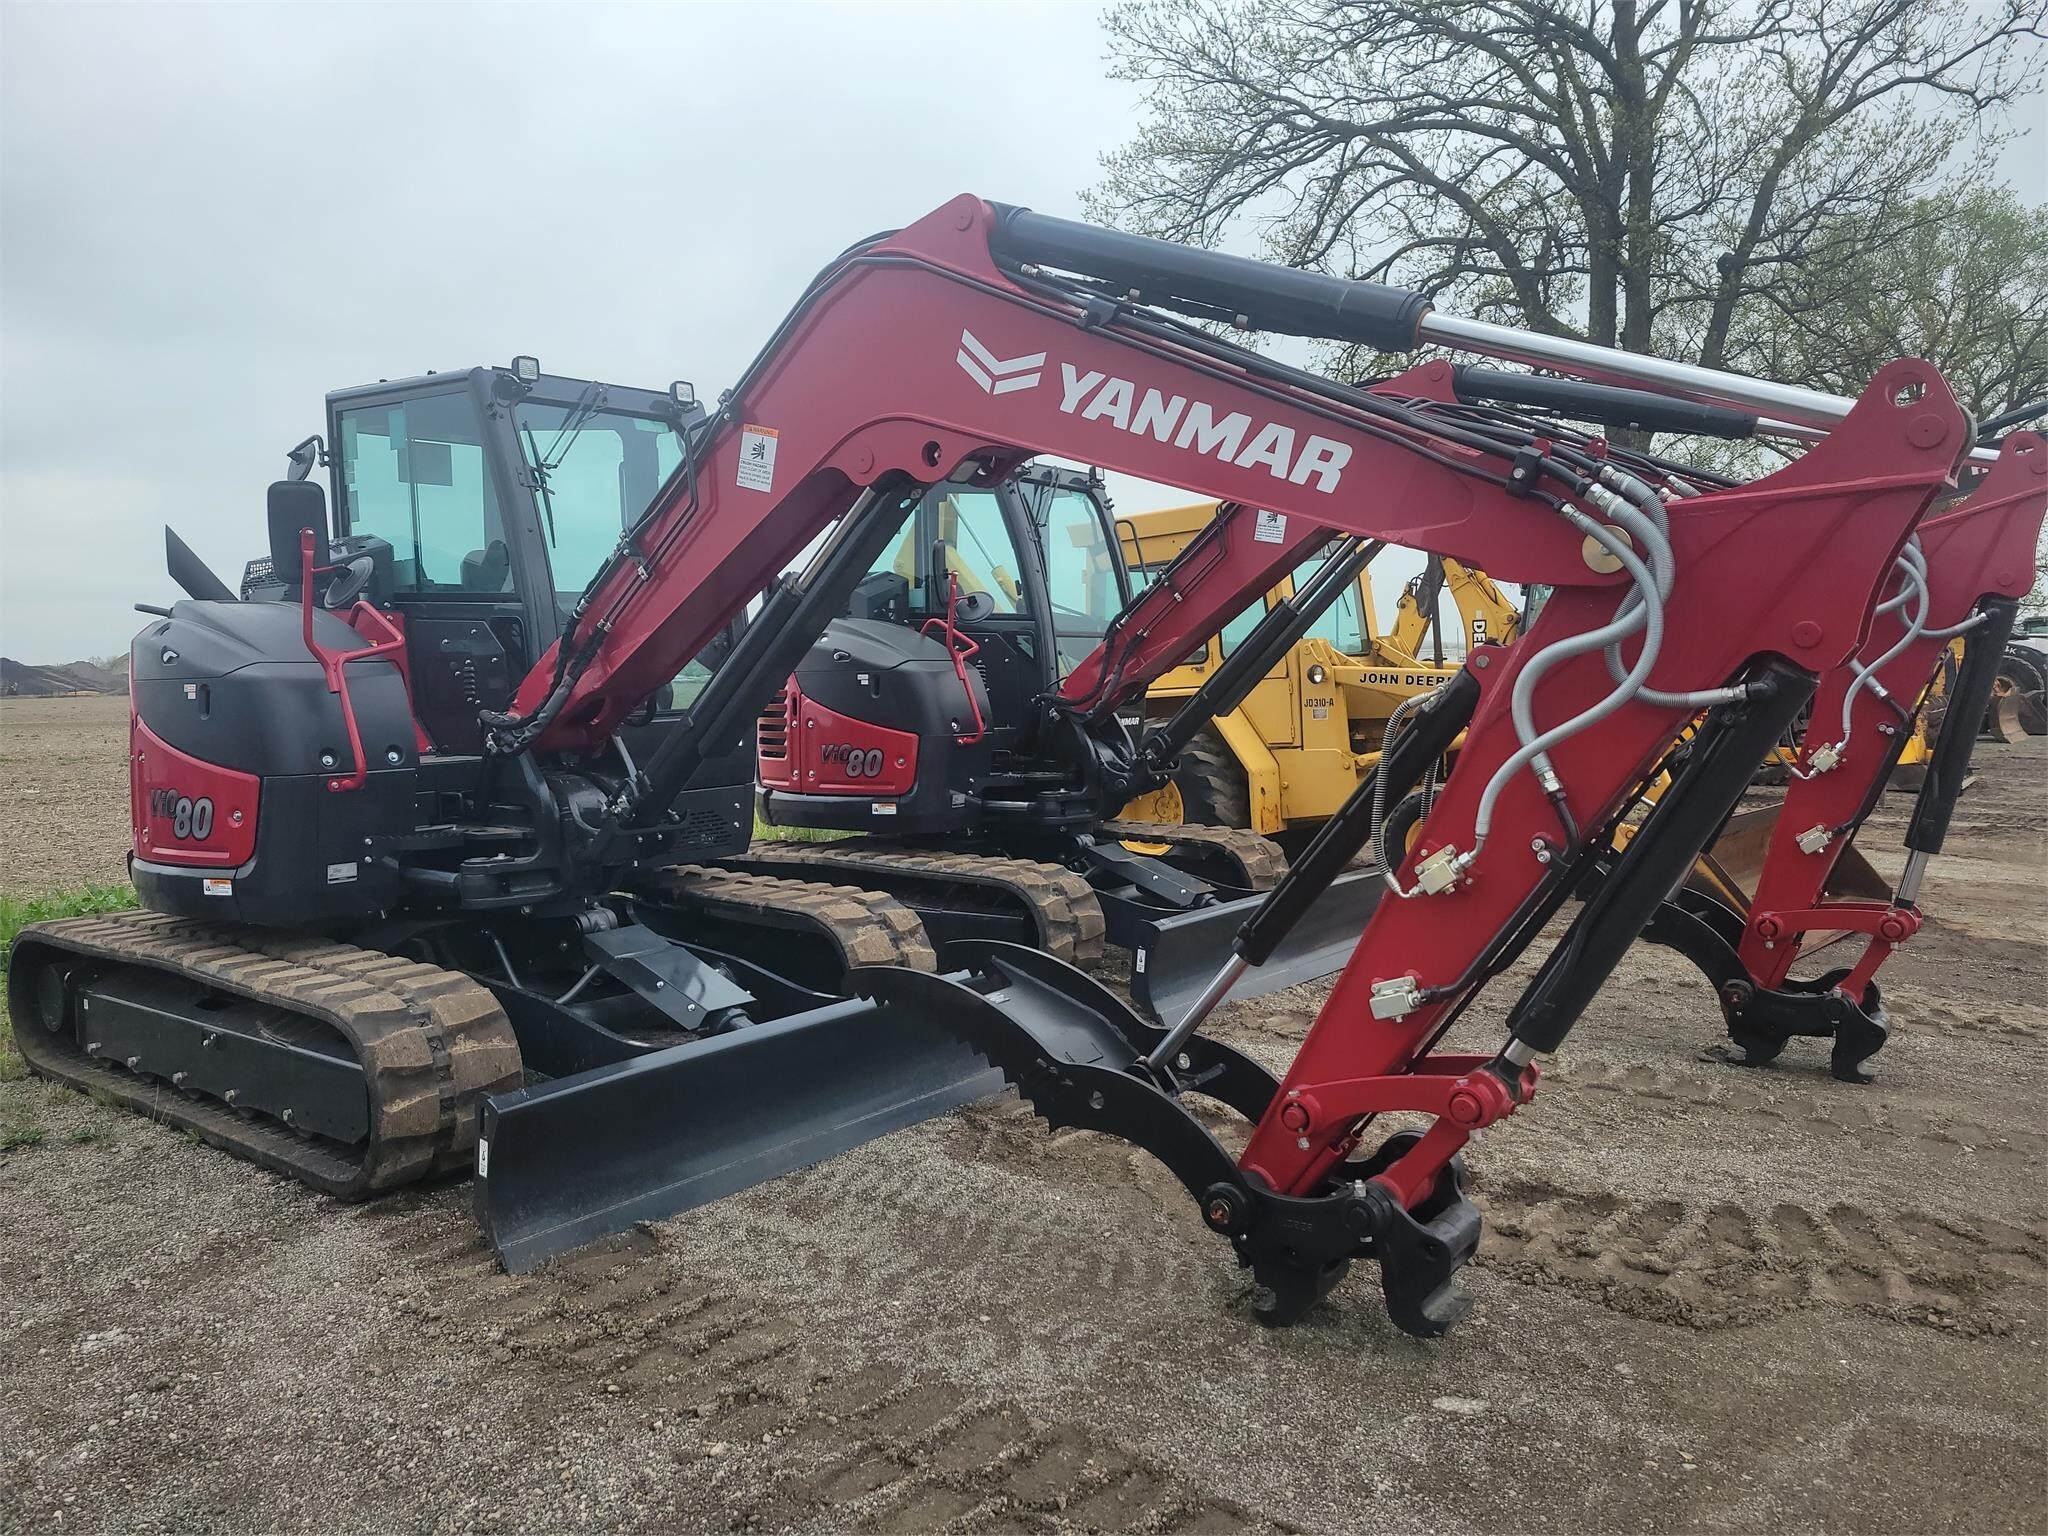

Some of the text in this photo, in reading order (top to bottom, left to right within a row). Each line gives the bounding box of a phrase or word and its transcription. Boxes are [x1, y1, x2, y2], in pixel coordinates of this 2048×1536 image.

[1059, 362, 1352, 494] YANMAR
[1359, 673, 1399, 684] JOHN
[1304, 697, 1334, 708] JD310-A
